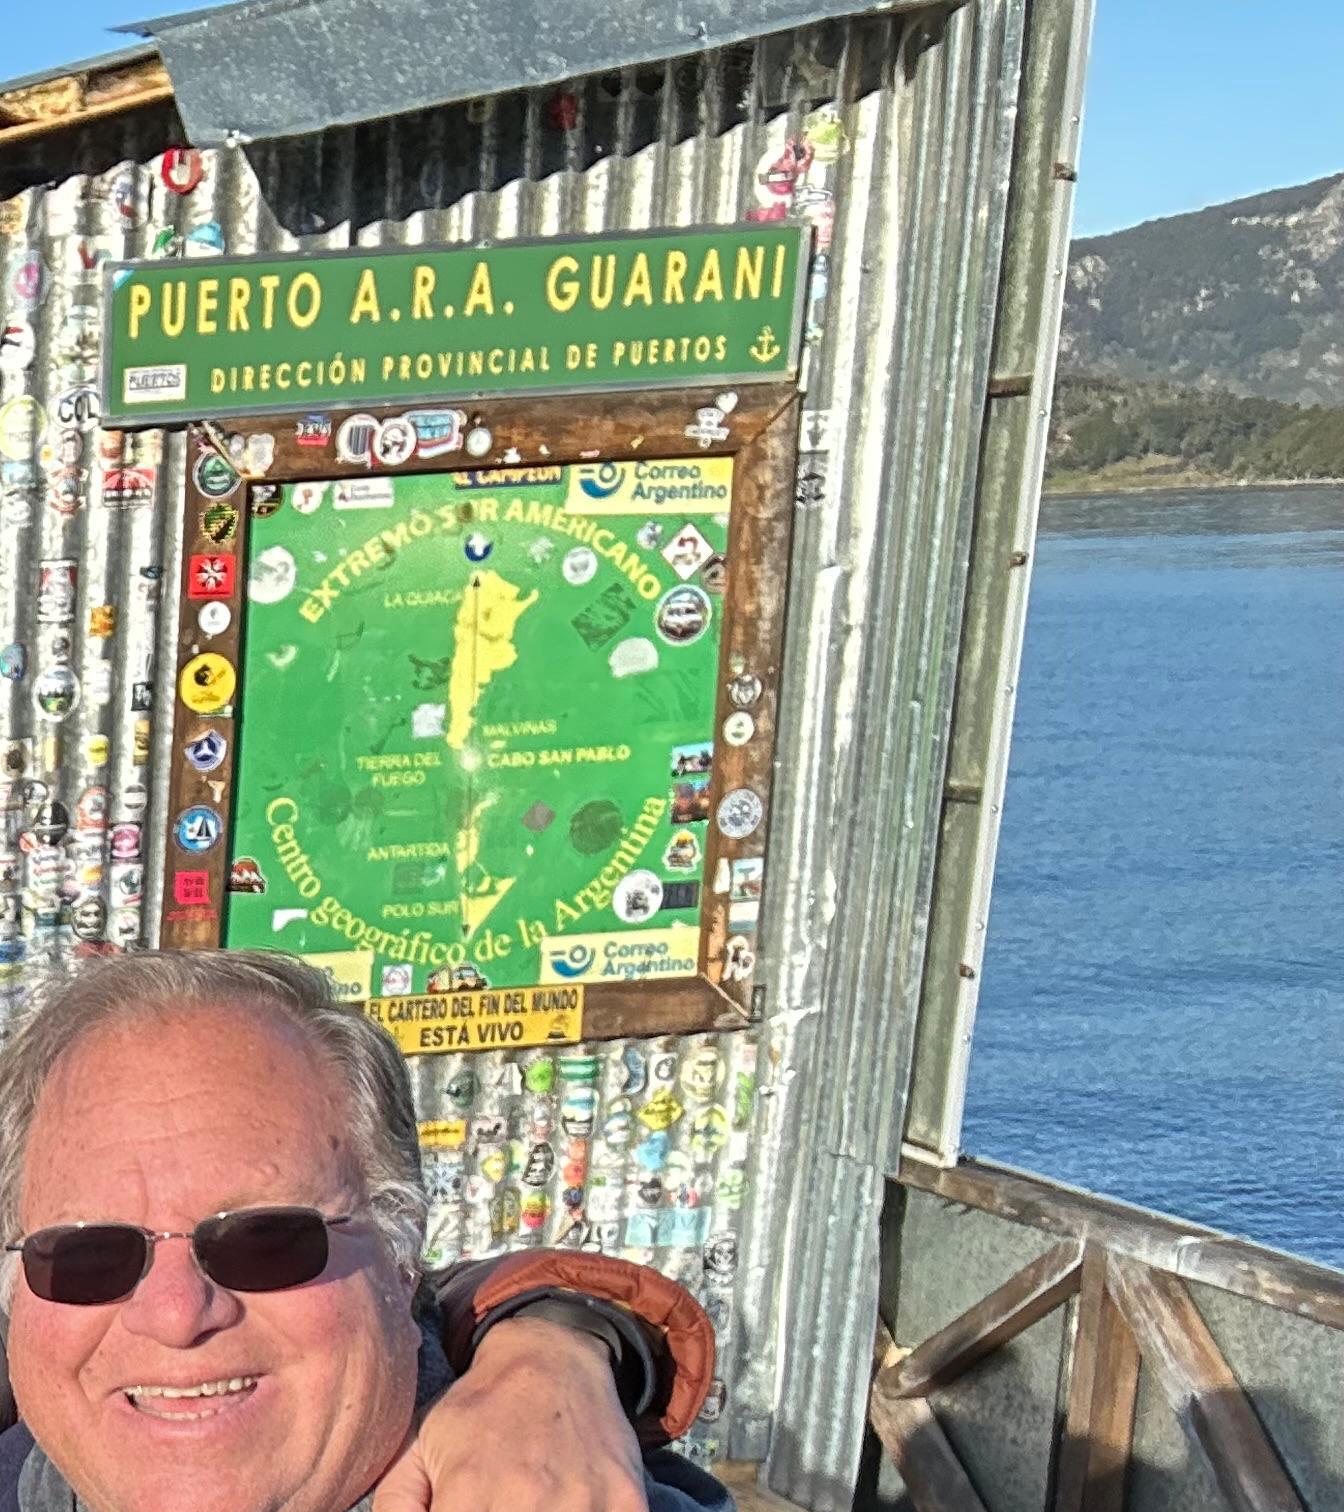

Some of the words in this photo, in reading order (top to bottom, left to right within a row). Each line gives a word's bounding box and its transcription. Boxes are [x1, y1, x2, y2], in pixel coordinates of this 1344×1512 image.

[127, 270, 321, 338] PUERTO
[350, 260, 514, 322] A.R.A.
[545, 244, 786, 313] GUARANI
[211, 352, 366, 393] DIRECCIÓN
[382, 345, 550, 383] PROVINCIAL
[566, 341, 599, 371] DE
[613, 333, 727, 368] PUERTOS
[634, 460, 702, 480] Correo
[632, 482, 727, 504] Argentino
[299, 514, 433, 624] EXTREMO
[510, 498, 662, 600] AMERICANO
[487, 751, 535, 769] CABO
[538, 748, 573, 766] SAN
[575, 744, 631, 763] PABLO
[266, 797, 321, 899] Centro
[310, 896, 466, 967] geográfico
[474, 929, 511, 962] de
[516, 918, 548, 947] la
[554, 795, 666, 931] Argentina
[382, 902, 425, 919] POLO
[388, 997, 448, 1022] CARTERO
[451, 995, 476, 1018] DEL
[479, 993, 501, 1017] FIN
[503, 992, 528, 1014] DEL
[531, 989, 579, 1012] MUNDO
[477, 1020, 525, 1043] VIVO
